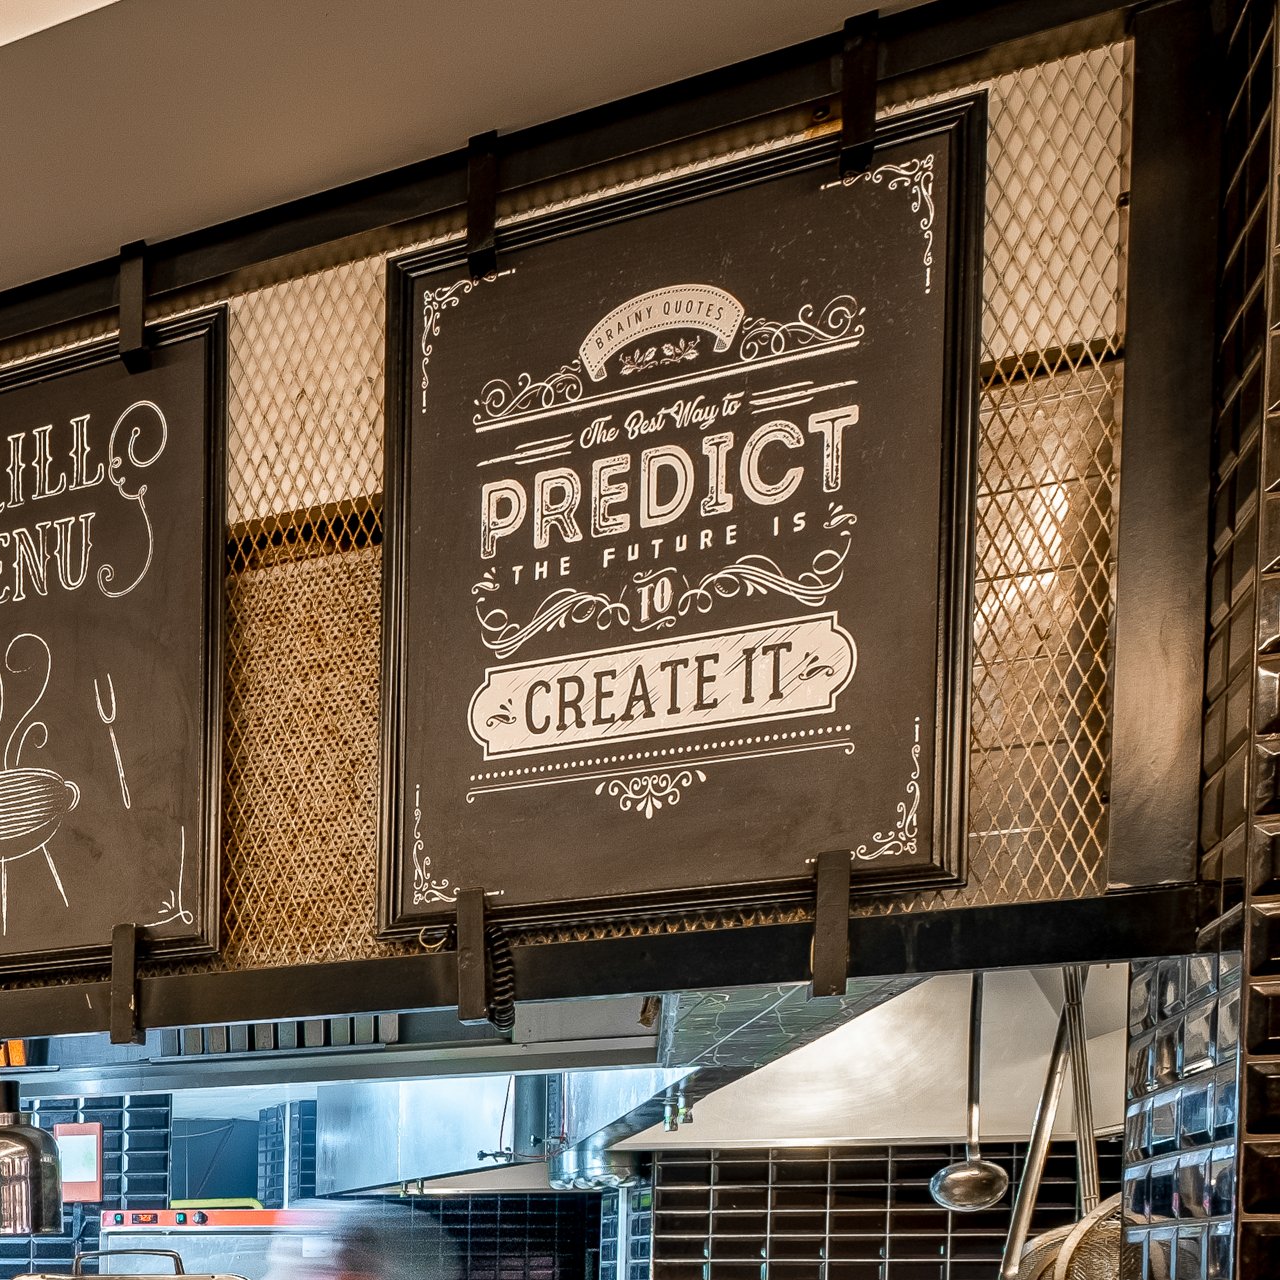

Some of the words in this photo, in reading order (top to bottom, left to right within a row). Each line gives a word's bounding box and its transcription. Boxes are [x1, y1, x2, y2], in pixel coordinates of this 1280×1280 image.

[595, 306, 653, 350] BRAINY
[662, 299, 724, 322] QUOTES
[580, 414, 619, 449] The
[624, 410, 667, 440] Best
[668, 395, 719, 430] Way
[722, 391, 745, 416] to
[480, 404, 860, 559] PREDICT
[512, 556, 571, 584] THE
[602, 524, 738, 568] FUTURE
[773, 511, 807, 536] IS
[637, 576, 674, 623] TO
[525, 652, 720, 735] CREATE
[741, 641, 793, 703] IT
